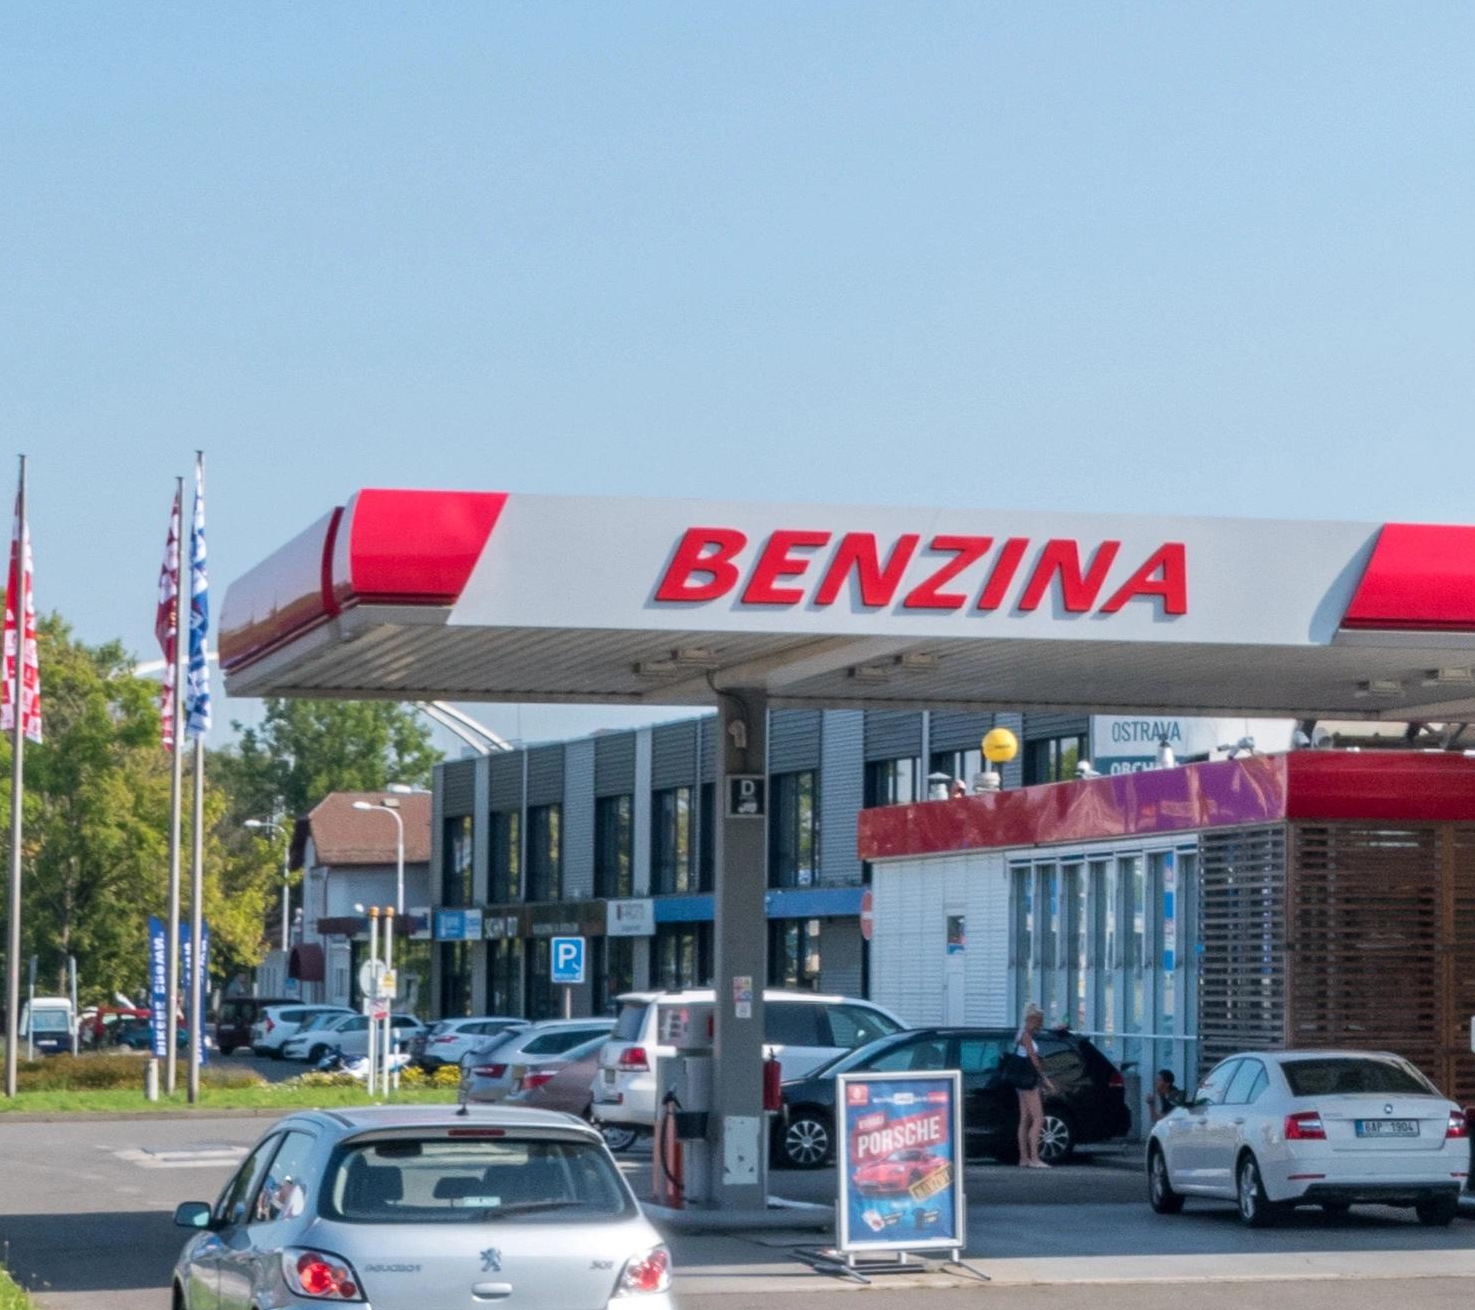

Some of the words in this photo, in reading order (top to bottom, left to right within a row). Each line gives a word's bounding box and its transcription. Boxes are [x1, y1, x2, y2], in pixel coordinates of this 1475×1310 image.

[654, 526, 1189, 616] BENZINA
[1111, 720, 1182, 742] OSTRAVA
[740, 779, 756, 796] D
[557, 943, 577, 969] P
[858, 1115, 941, 1158] PORSCHE
